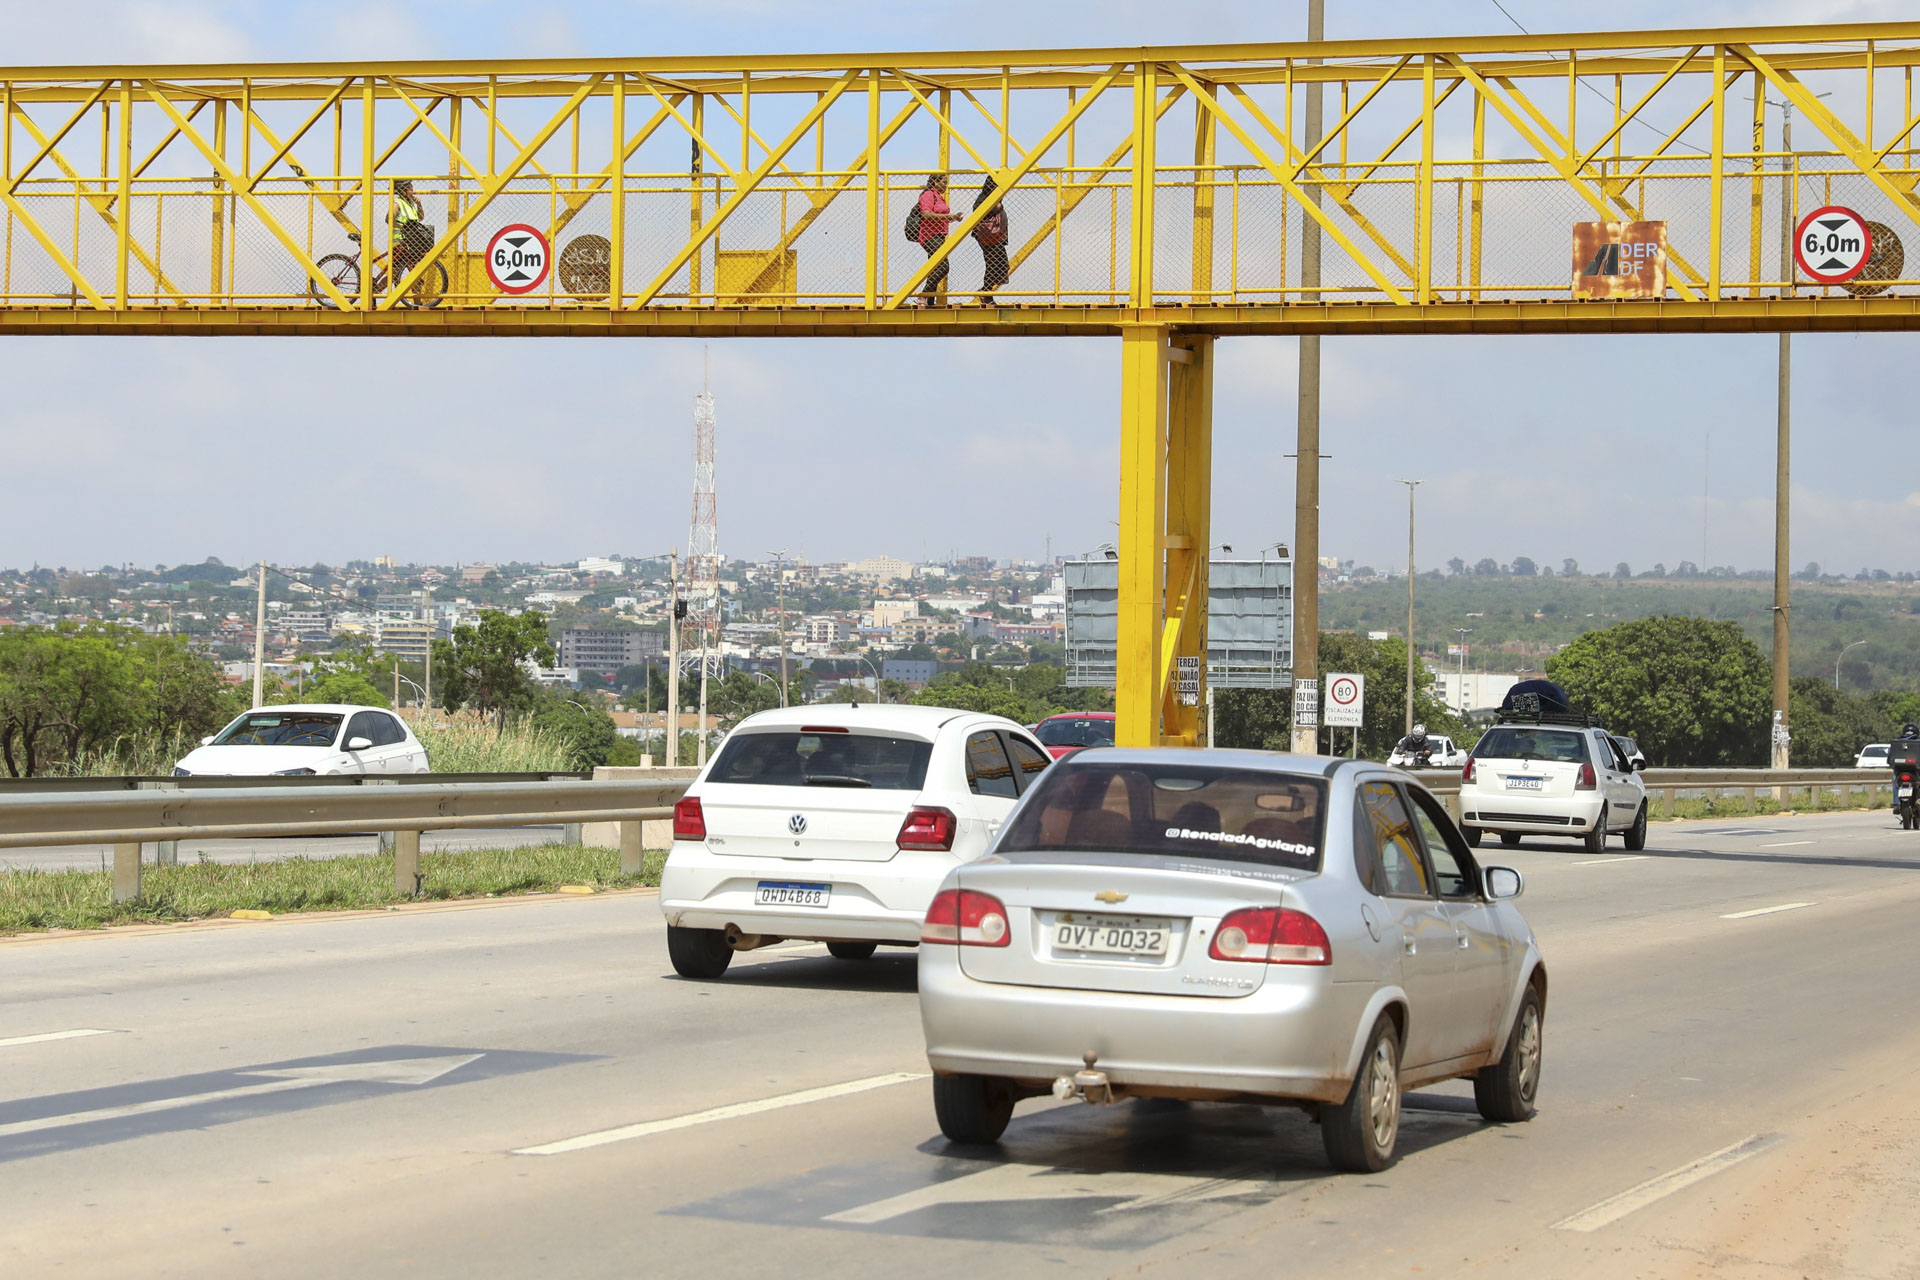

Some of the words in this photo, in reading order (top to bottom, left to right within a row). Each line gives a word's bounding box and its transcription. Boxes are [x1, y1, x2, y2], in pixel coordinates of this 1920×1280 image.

[1620, 242, 1658, 258] DER
[1805, 233, 1860, 256] 6,0m
[494, 248, 541, 270] 6,0m
[1620, 260, 1644, 276] DF
[1176, 657, 1198, 668] TEREZA
[1178, 681, 1198, 691] CASAL
[1337, 686, 1352, 697] 80
[1296, 692, 1306, 702] FAZ
[1296, 702, 1304, 711] DO
